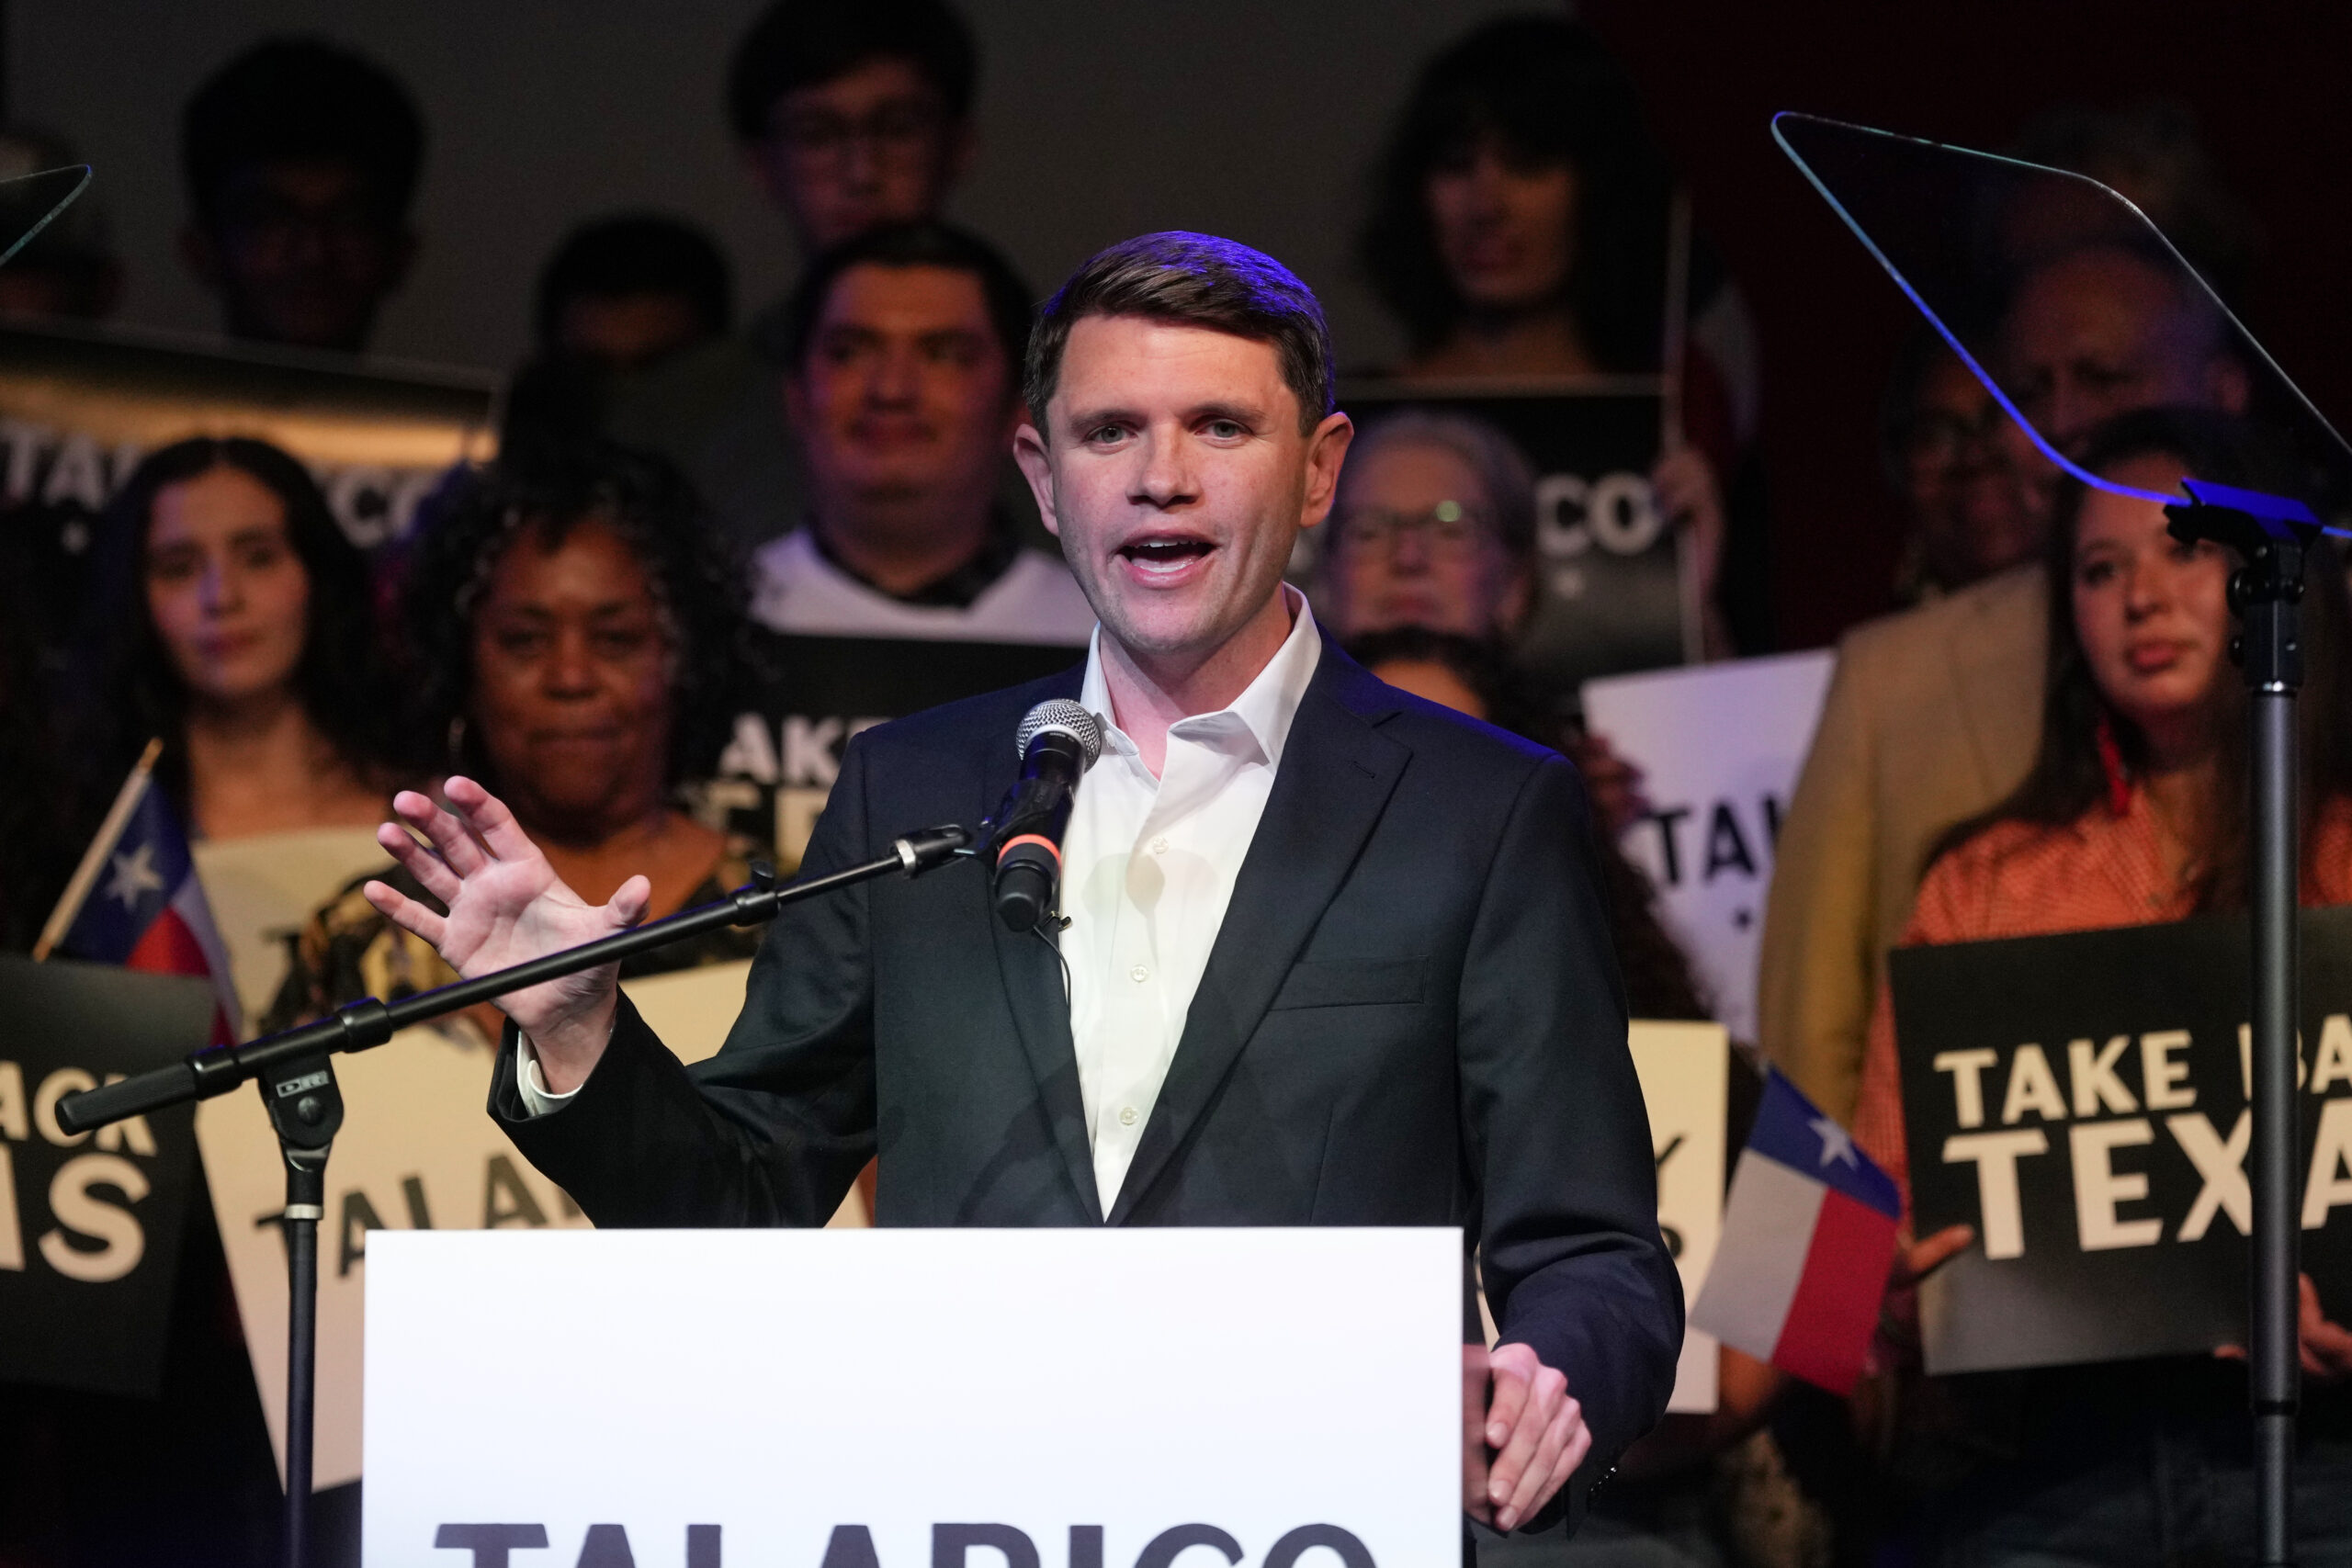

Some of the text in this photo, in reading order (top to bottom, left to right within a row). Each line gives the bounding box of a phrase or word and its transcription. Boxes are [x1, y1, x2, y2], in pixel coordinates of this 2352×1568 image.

[1933, 1013, 2352, 1129] TAKE A
[0, 1142, 152, 1283] S
